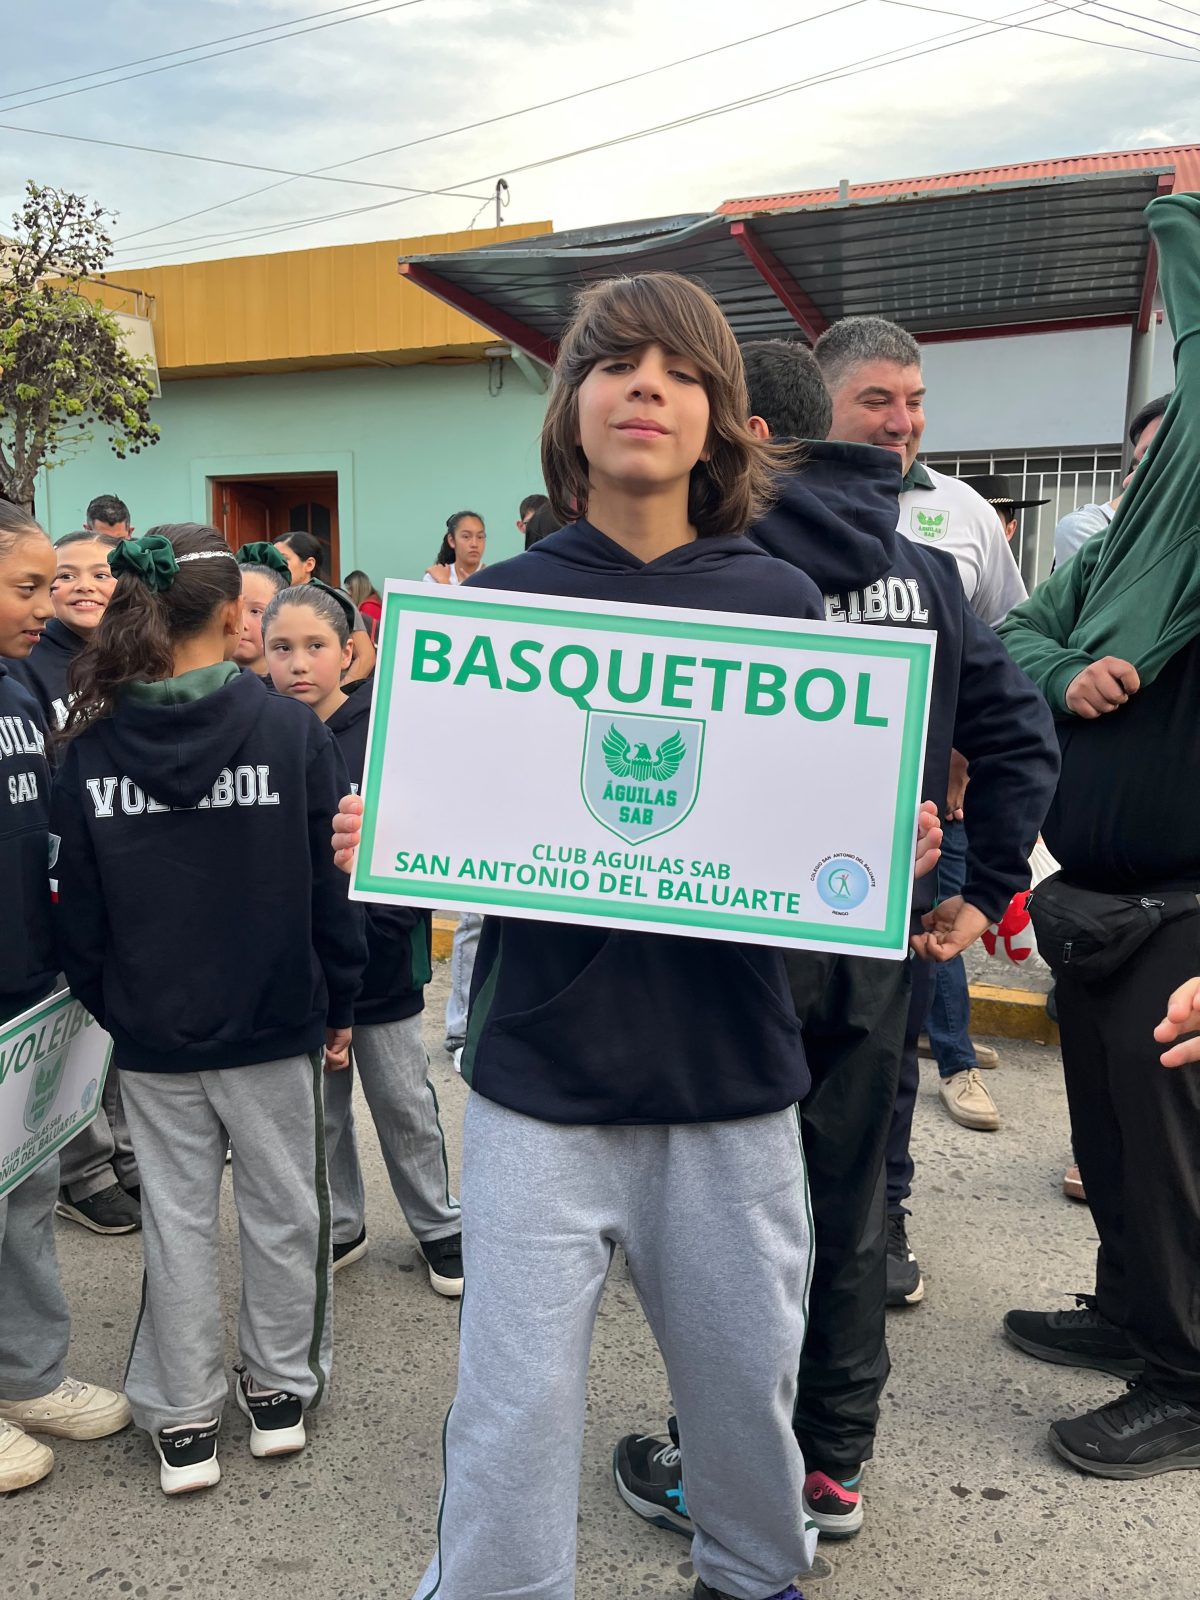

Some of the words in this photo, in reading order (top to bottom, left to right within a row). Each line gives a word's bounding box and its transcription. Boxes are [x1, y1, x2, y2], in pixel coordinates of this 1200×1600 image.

[823, 576, 929, 624] EIBOL
[410, 628, 890, 728] BASQUETBOL
[8, 771, 39, 805] SAB
[86, 765, 280, 818] VOBOL
[602, 780, 678, 808] ÁGUILAS
[618, 806, 654, 826] SAB
[394, 851, 451, 877] SAN
[457, 858, 590, 891] ANTONIO
[598, 872, 648, 898] DEL
[657, 878, 801, 915] BALUARTE
[532, 843, 587, 865] CLUB
[592, 850, 685, 875] AGUILAS
[690, 860, 731, 880] SAB
[0, 1002, 95, 1086] VOLEIB
